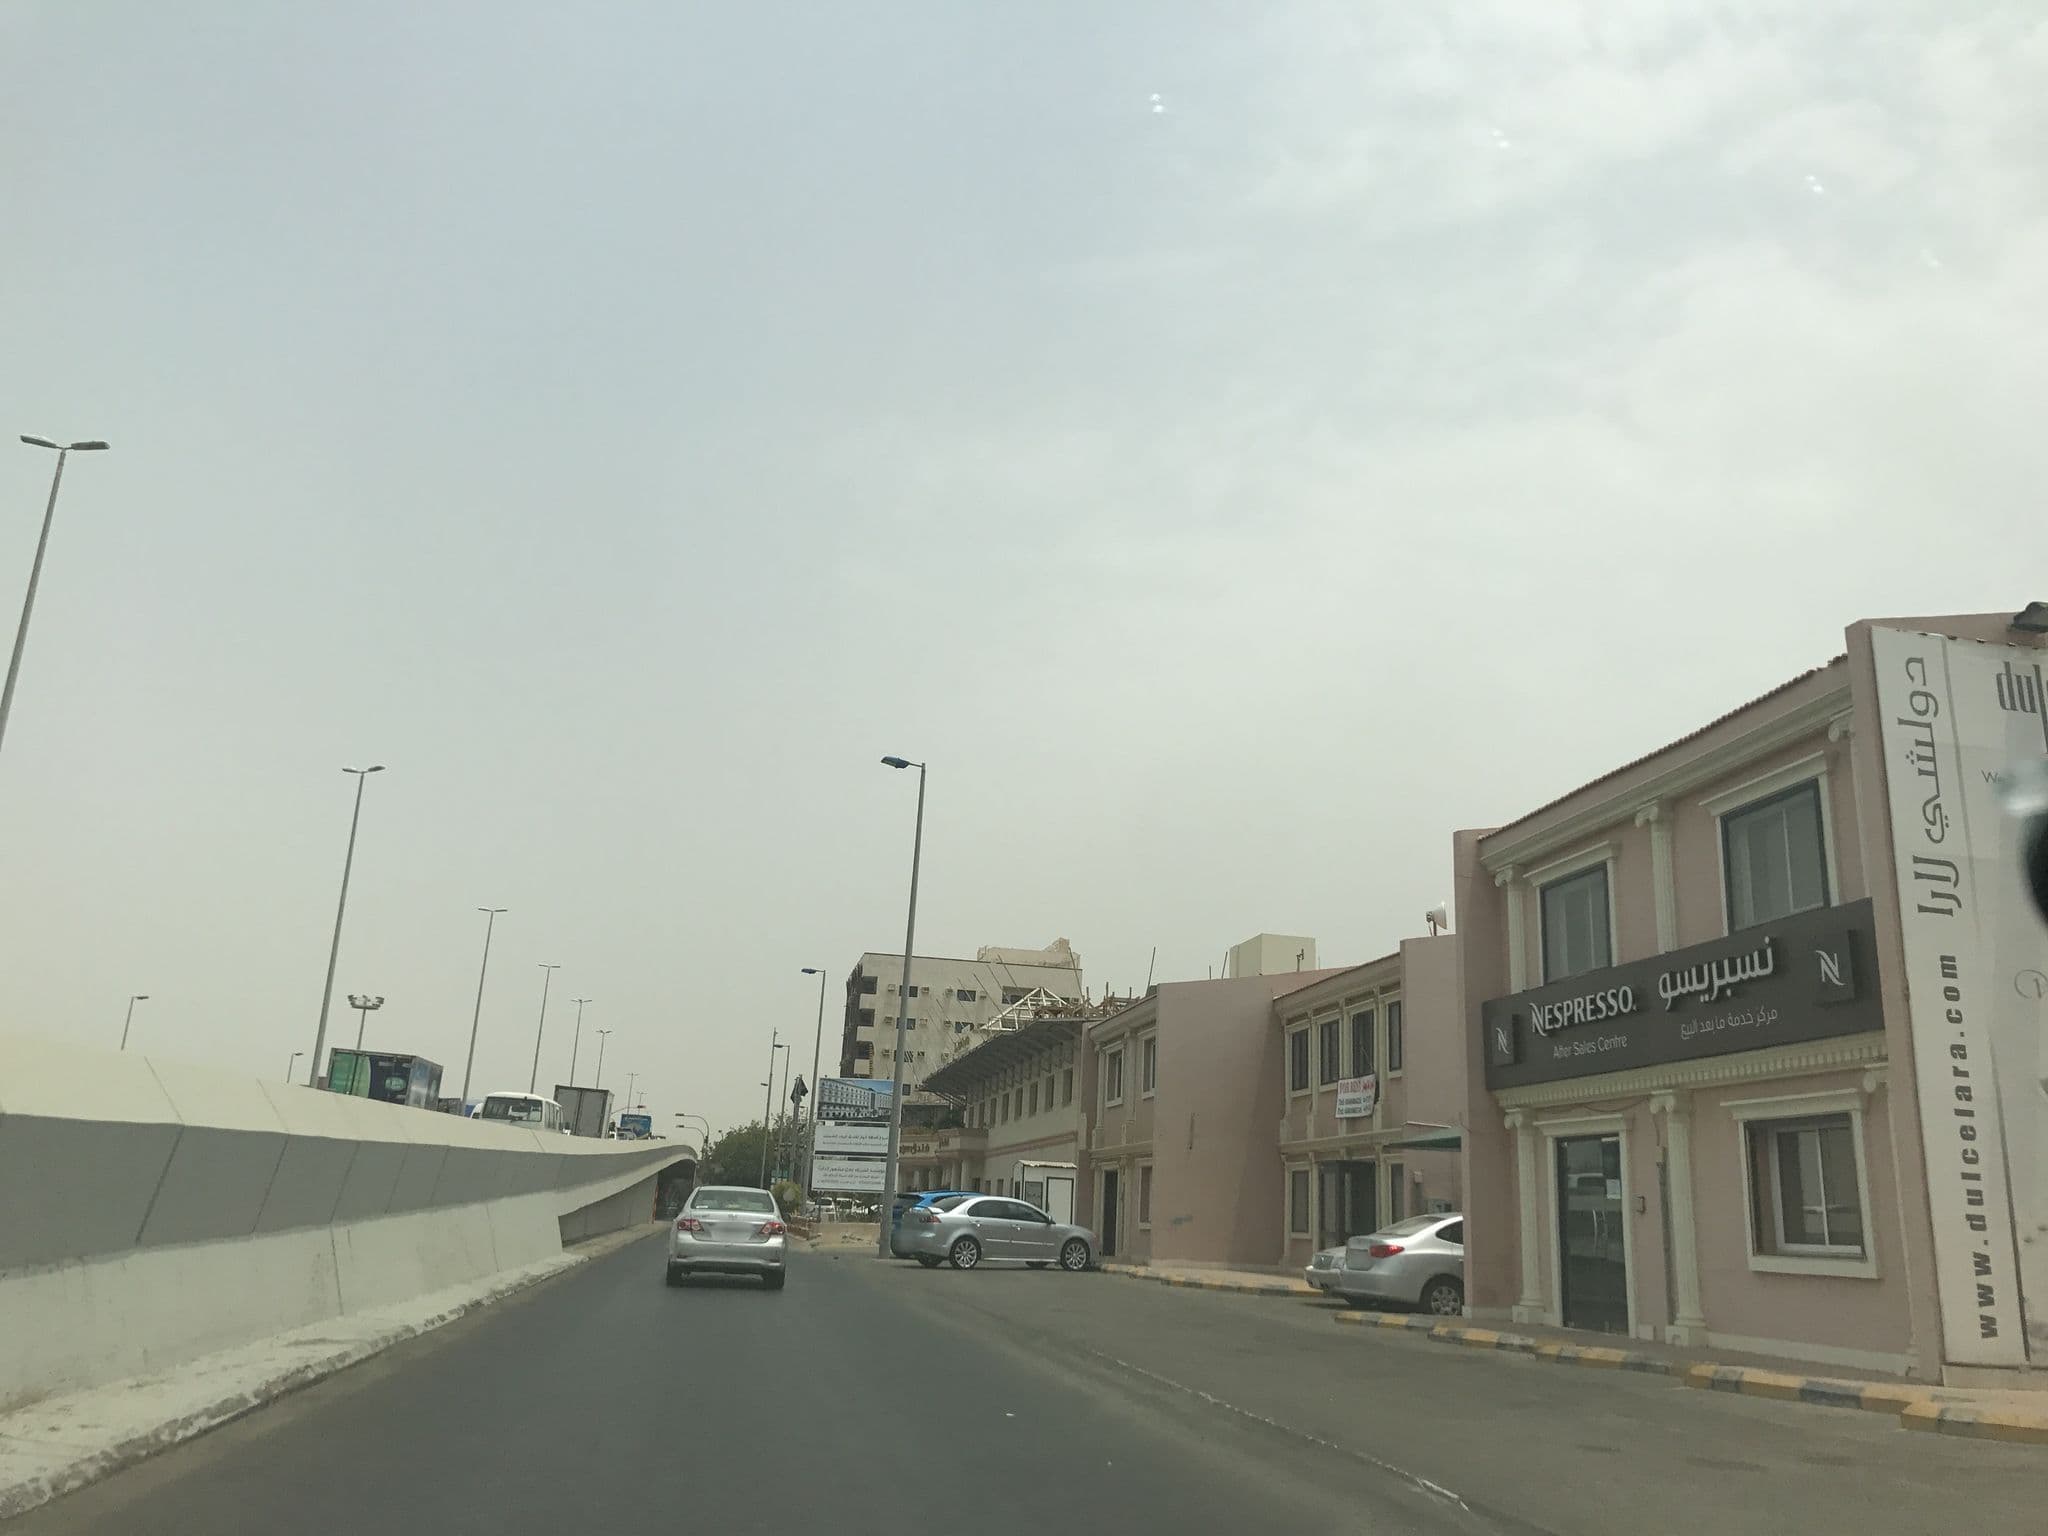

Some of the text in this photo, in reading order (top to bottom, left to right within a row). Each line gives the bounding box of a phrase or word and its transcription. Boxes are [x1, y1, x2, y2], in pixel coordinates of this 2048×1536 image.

[1996, 661, 2048, 754] dul
[1897, 656, 1963, 918] دولشي لارا
[1658, 936, 1774, 1011] نسبريسو
[1528, 985, 1634, 1037] NESPRESSO
[1727, 1008, 1754, 1027] خدمة
[1755, 1006, 1778, 1027] مركز
[1573, 1041, 1597, 1056] Sales
[1597, 1036, 1628, 1052] Centre
[1938, 953, 1999, 1340] www.dulcelara.com
